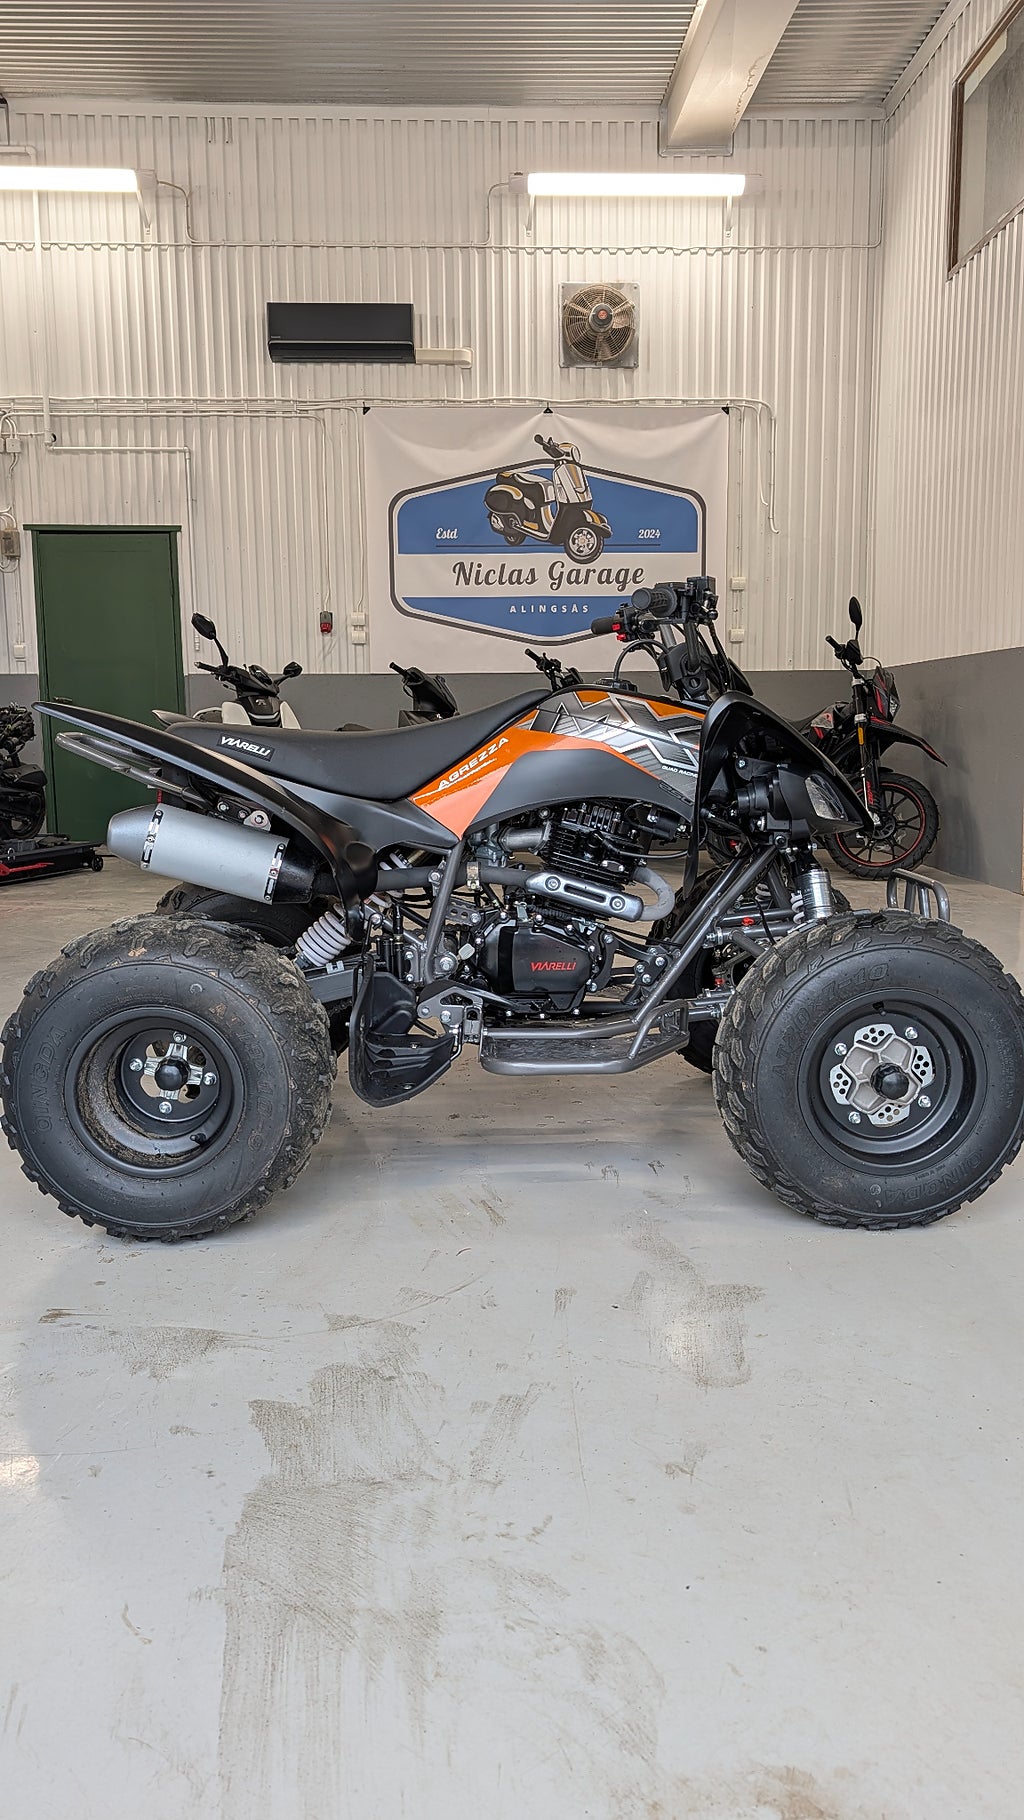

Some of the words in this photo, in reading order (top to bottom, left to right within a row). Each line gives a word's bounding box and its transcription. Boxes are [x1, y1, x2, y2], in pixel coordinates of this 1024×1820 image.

[436, 527, 458, 540] Estd
[638, 528, 661, 540] 2024
[452, 561, 539, 586] Niclas
[548, 560, 645, 592] Garage
[509, 603, 590, 614] ALINGSÅS
[221, 736, 270, 756] VIARELLI
[437, 736, 509, 790] AGREZZA
[661, 765, 677, 773] QUAD
[531, 961, 577, 972] VIARELLI
